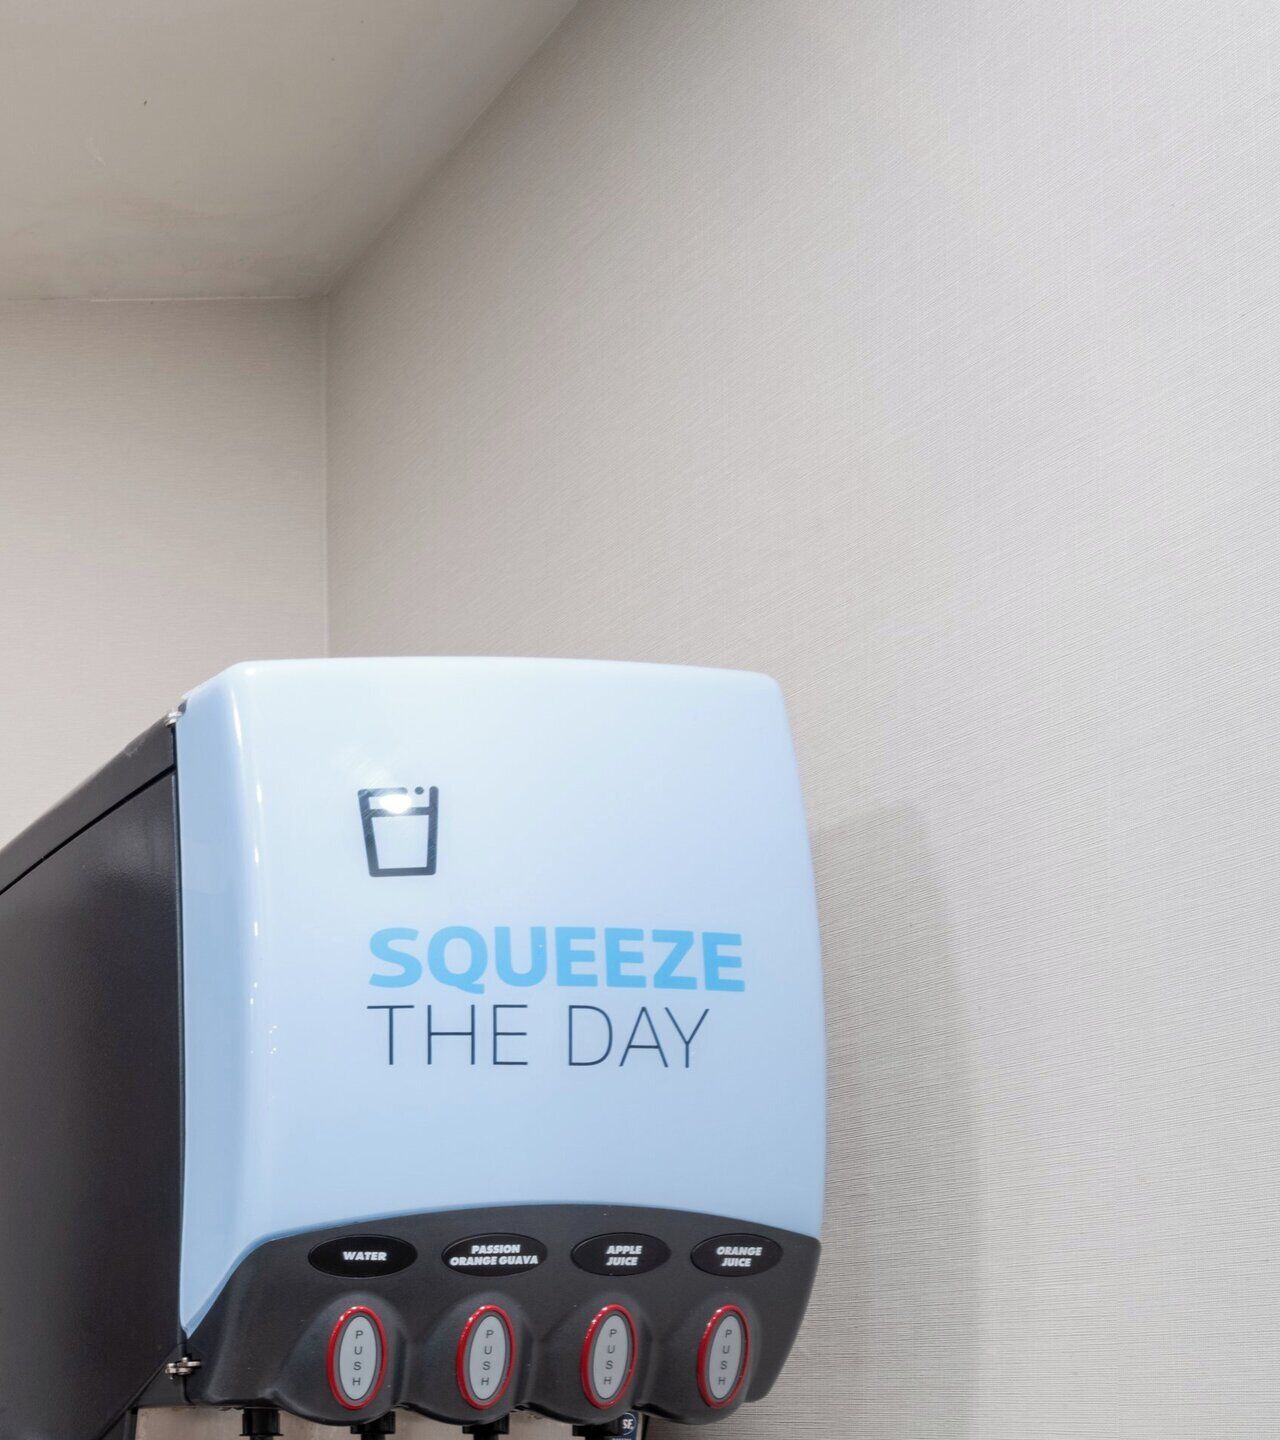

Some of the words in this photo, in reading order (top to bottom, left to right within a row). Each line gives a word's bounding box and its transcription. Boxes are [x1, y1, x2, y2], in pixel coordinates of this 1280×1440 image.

[369, 926, 745, 994] SQUEEZE
[367, 1004, 528, 1066] THE
[568, 1004, 710, 1068] DAY
[471, 1244, 521, 1254] PASSION
[606, 1245, 643, 1255] APPLE
[716, 1246, 763, 1256] ORANGE
[343, 1251, 387, 1261] WATER
[450, 1256, 497, 1266] ORANGE
[499, 1255, 539, 1265] GUAVA
[606, 1256, 639, 1266] JUICE
[721, 1257, 752, 1267] JUICE
[352, 1330, 364, 1386] PUSH
[481, 1329, 494, 1386] PUSH
[603, 1329, 618, 1385] PUSH
[718, 1329, 733, 1385] PUSH
